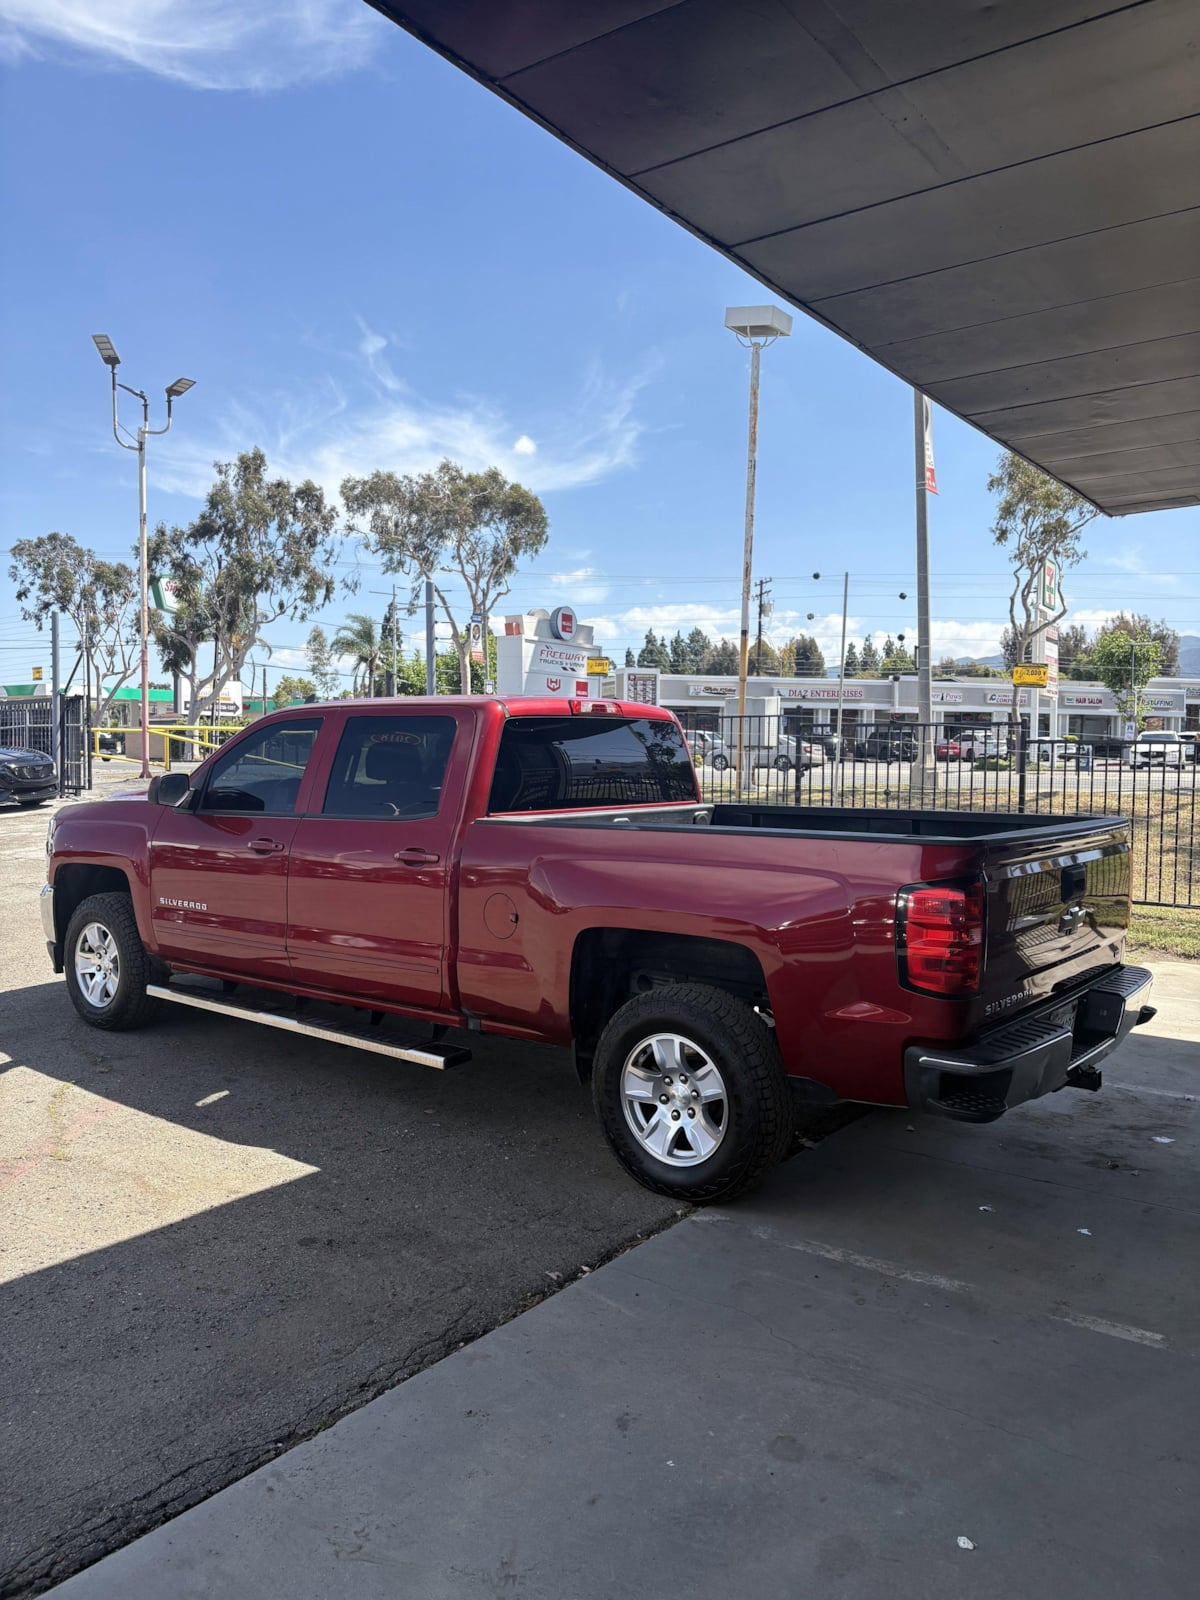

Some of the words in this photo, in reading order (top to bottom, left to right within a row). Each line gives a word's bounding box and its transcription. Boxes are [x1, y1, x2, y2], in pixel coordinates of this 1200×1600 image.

[540, 649, 586, 661] FREEWAY
[788, 689, 808, 698] DIAZ
[1088, 697, 1103, 705] SALON
[159, 897, 207, 910] SILVERADO
